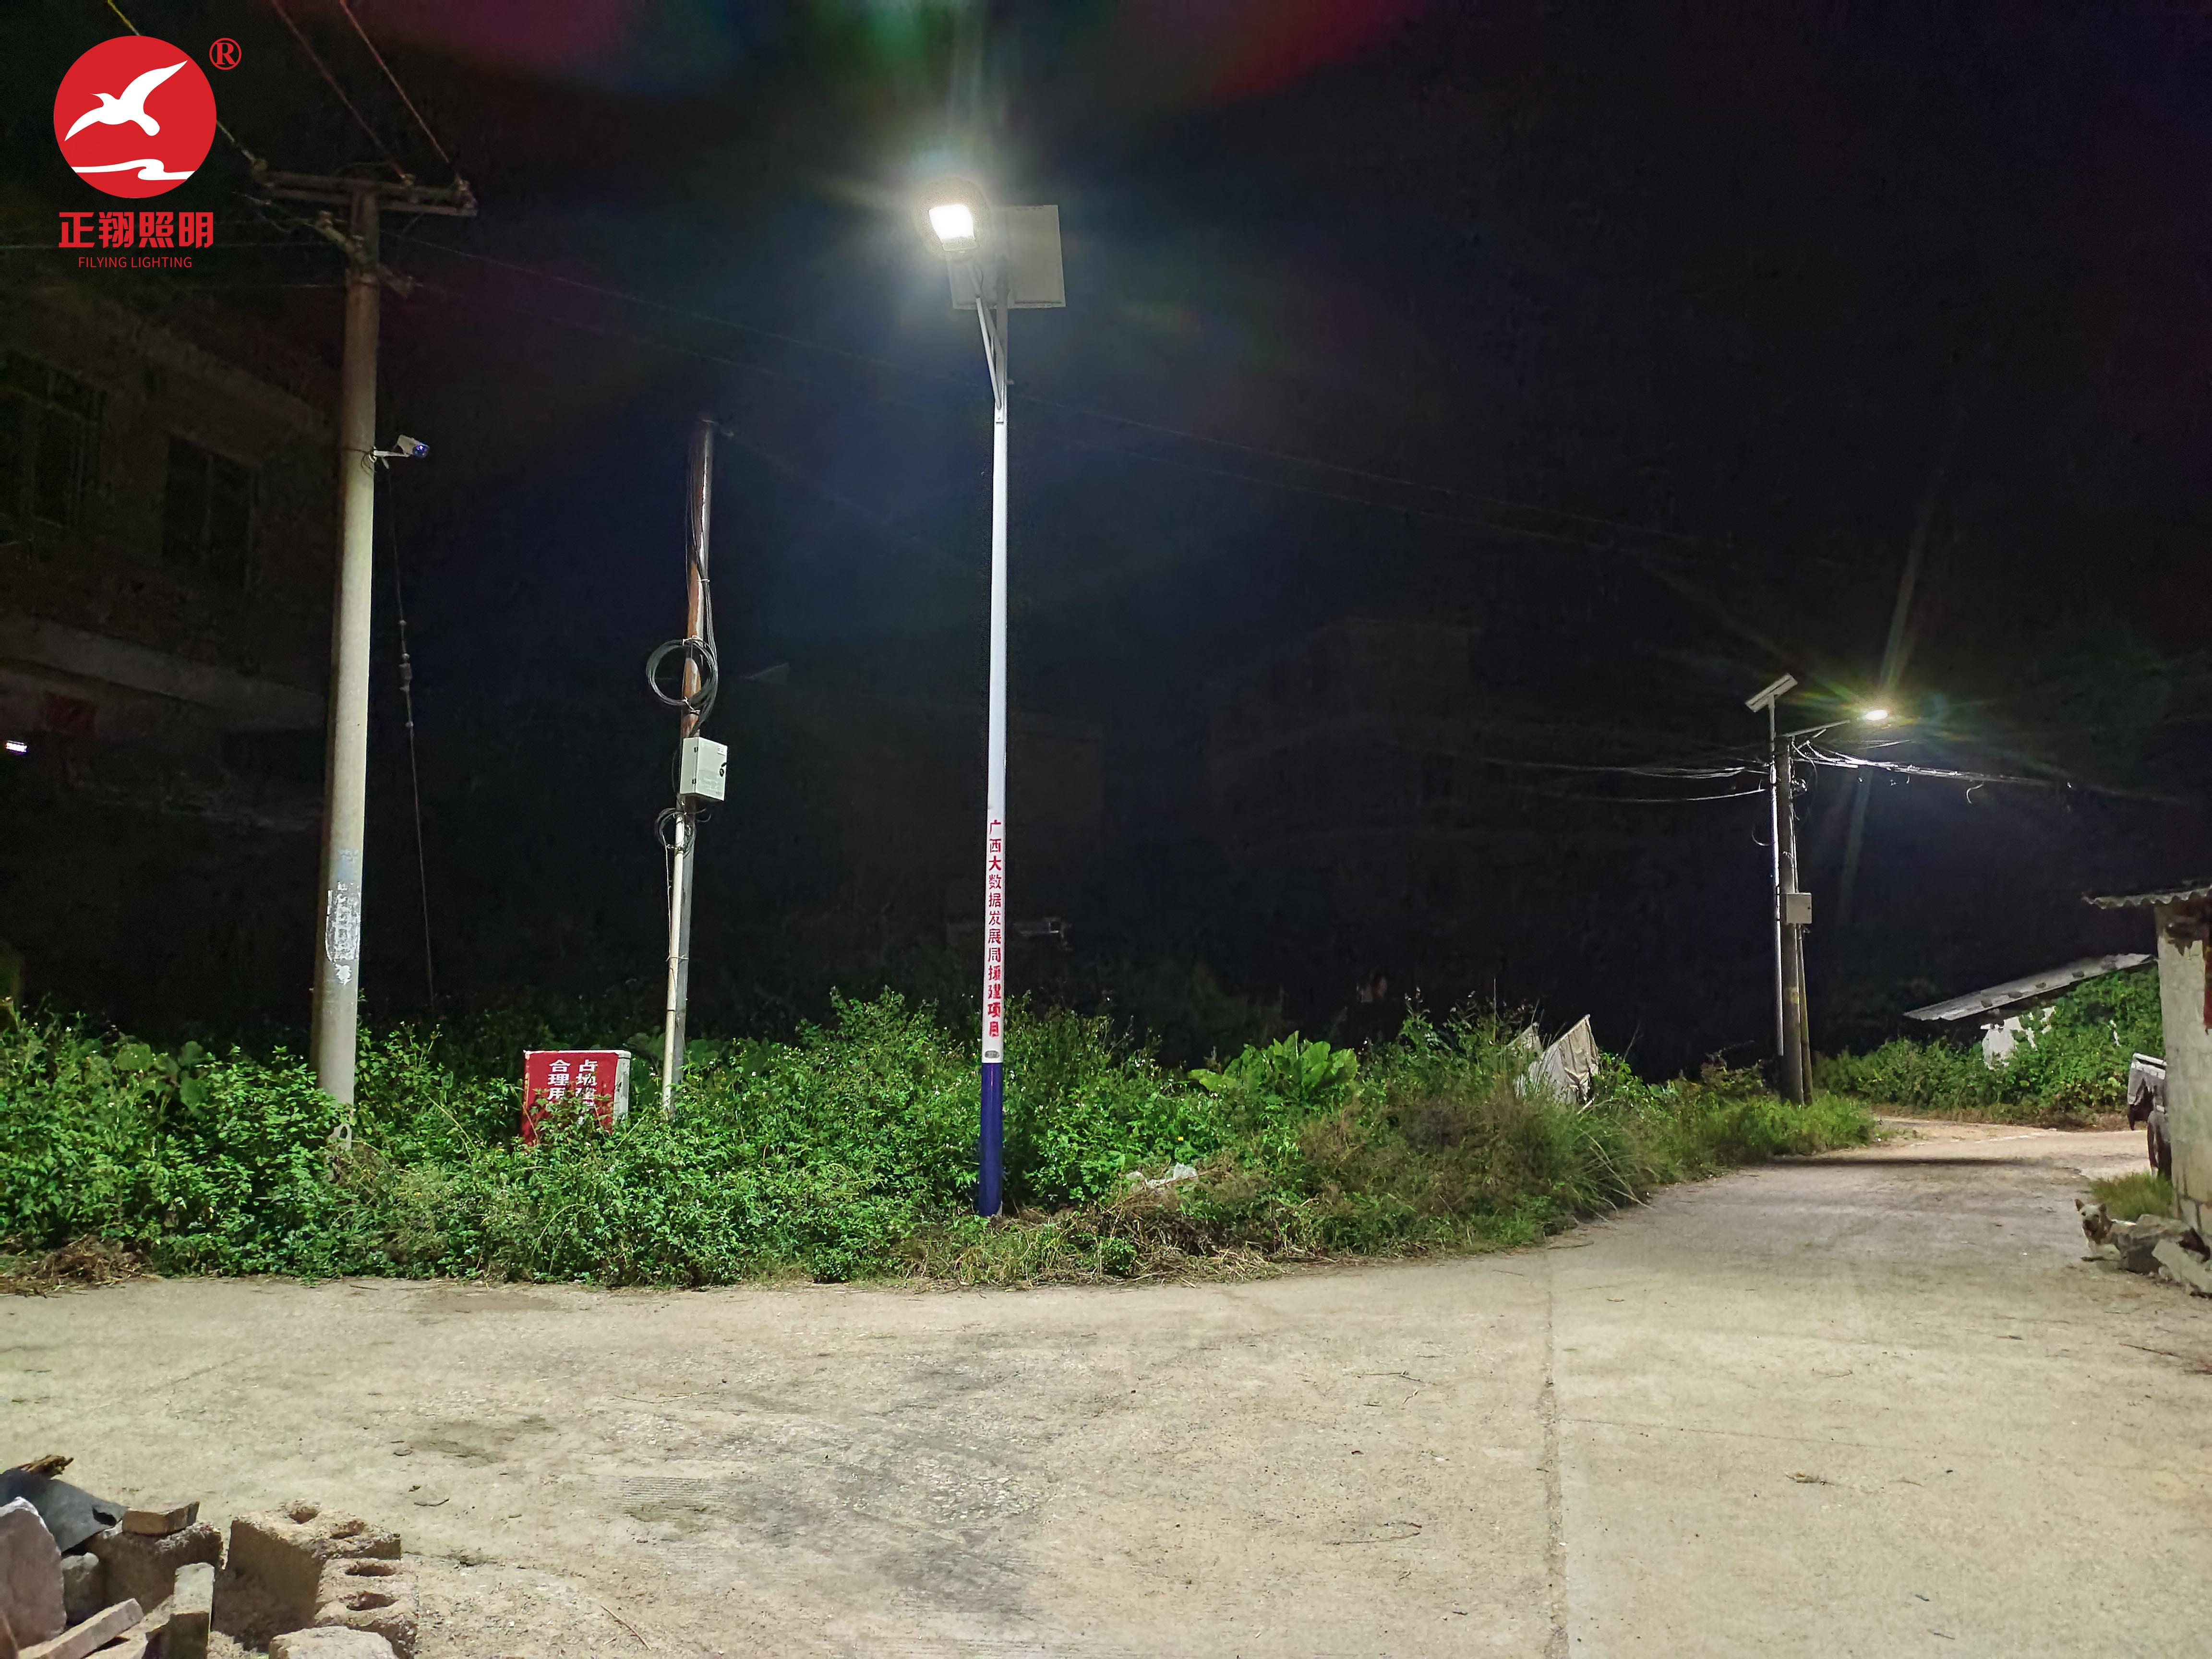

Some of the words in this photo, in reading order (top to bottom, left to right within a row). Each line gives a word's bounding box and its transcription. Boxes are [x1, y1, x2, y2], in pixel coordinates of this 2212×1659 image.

[987, 819, 1002, 1037] 广西大数据发展局援建项目
